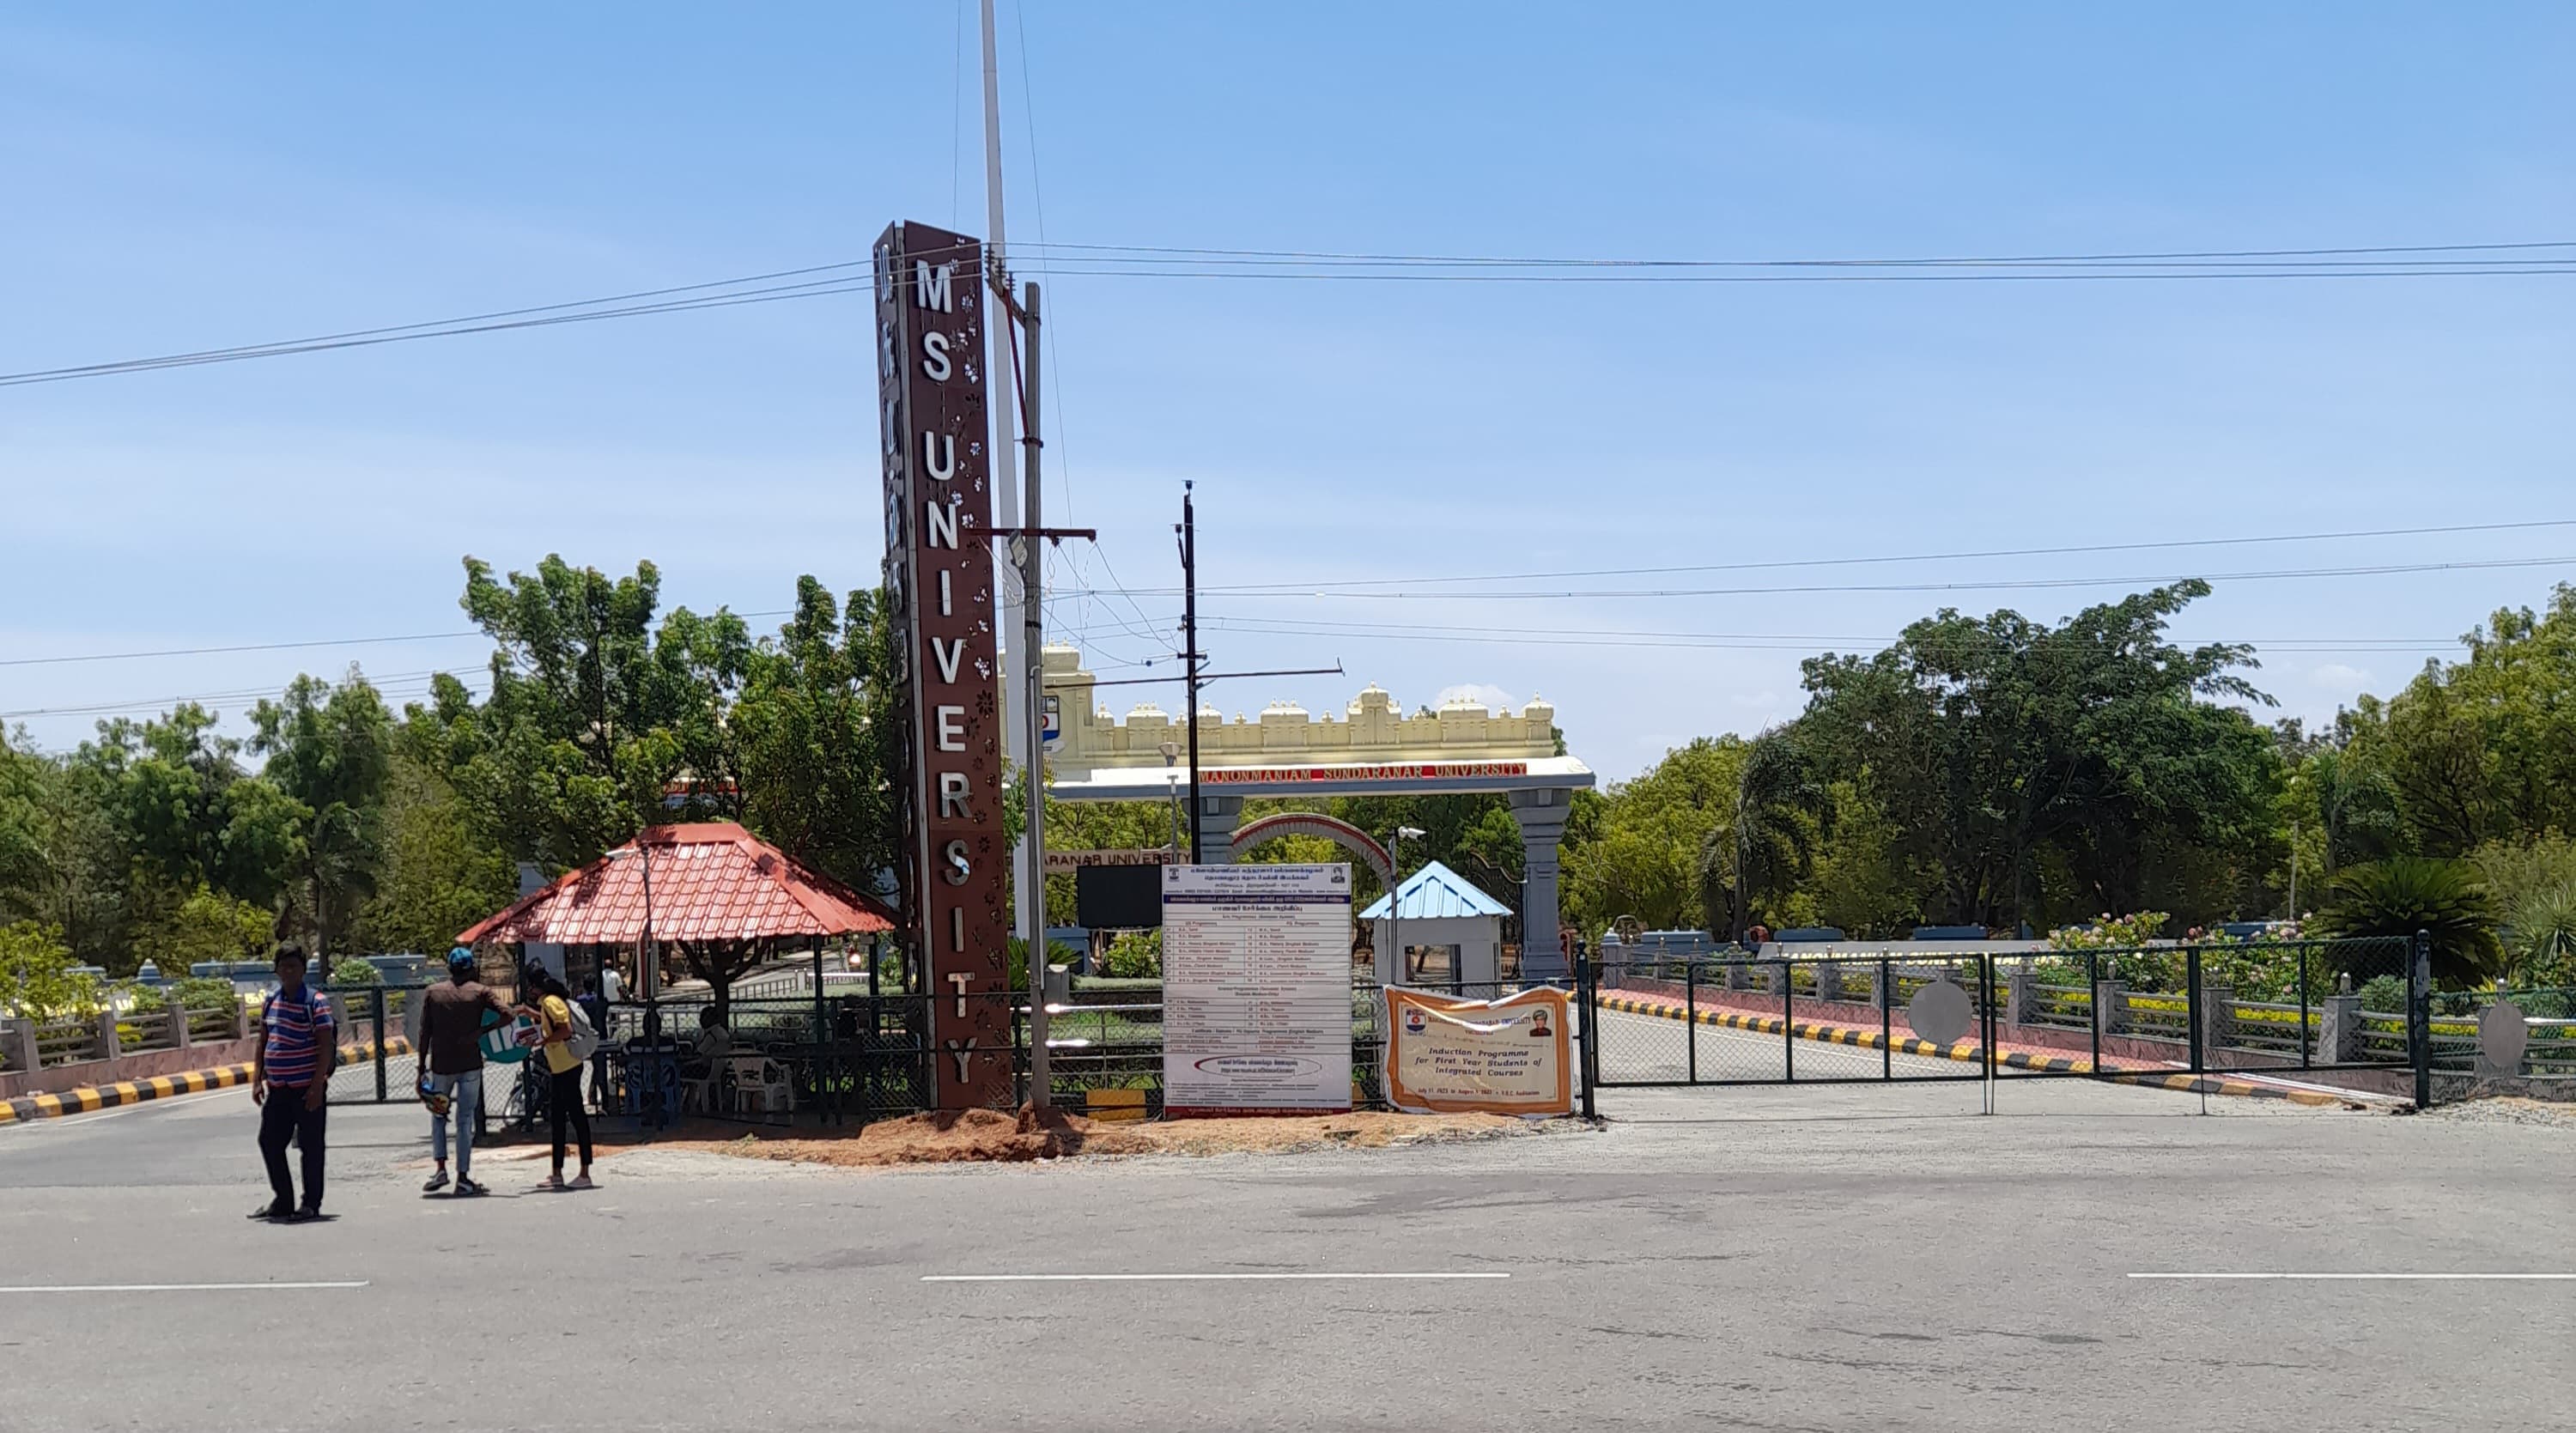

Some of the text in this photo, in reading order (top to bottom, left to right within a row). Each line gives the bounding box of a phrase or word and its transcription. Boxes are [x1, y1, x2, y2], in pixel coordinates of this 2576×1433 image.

[925, 429, 977, 1084] UNIVERSITY
[1198, 763, 1527, 782] MANONMANIAM SUNDARANAR UNIVERSITY
[1044, 854, 1103, 866] RANAR
[1428, 1047, 1529, 1059] Induction Programme
[1414, 1056, 1429, 1065] for
[1462, 1058, 1482, 1066] Year
[1486, 1059, 1528, 1067] Students
[1533, 1058, 1542, 1067] of
[1435, 1066, 1524, 1077] Integrated Courses
